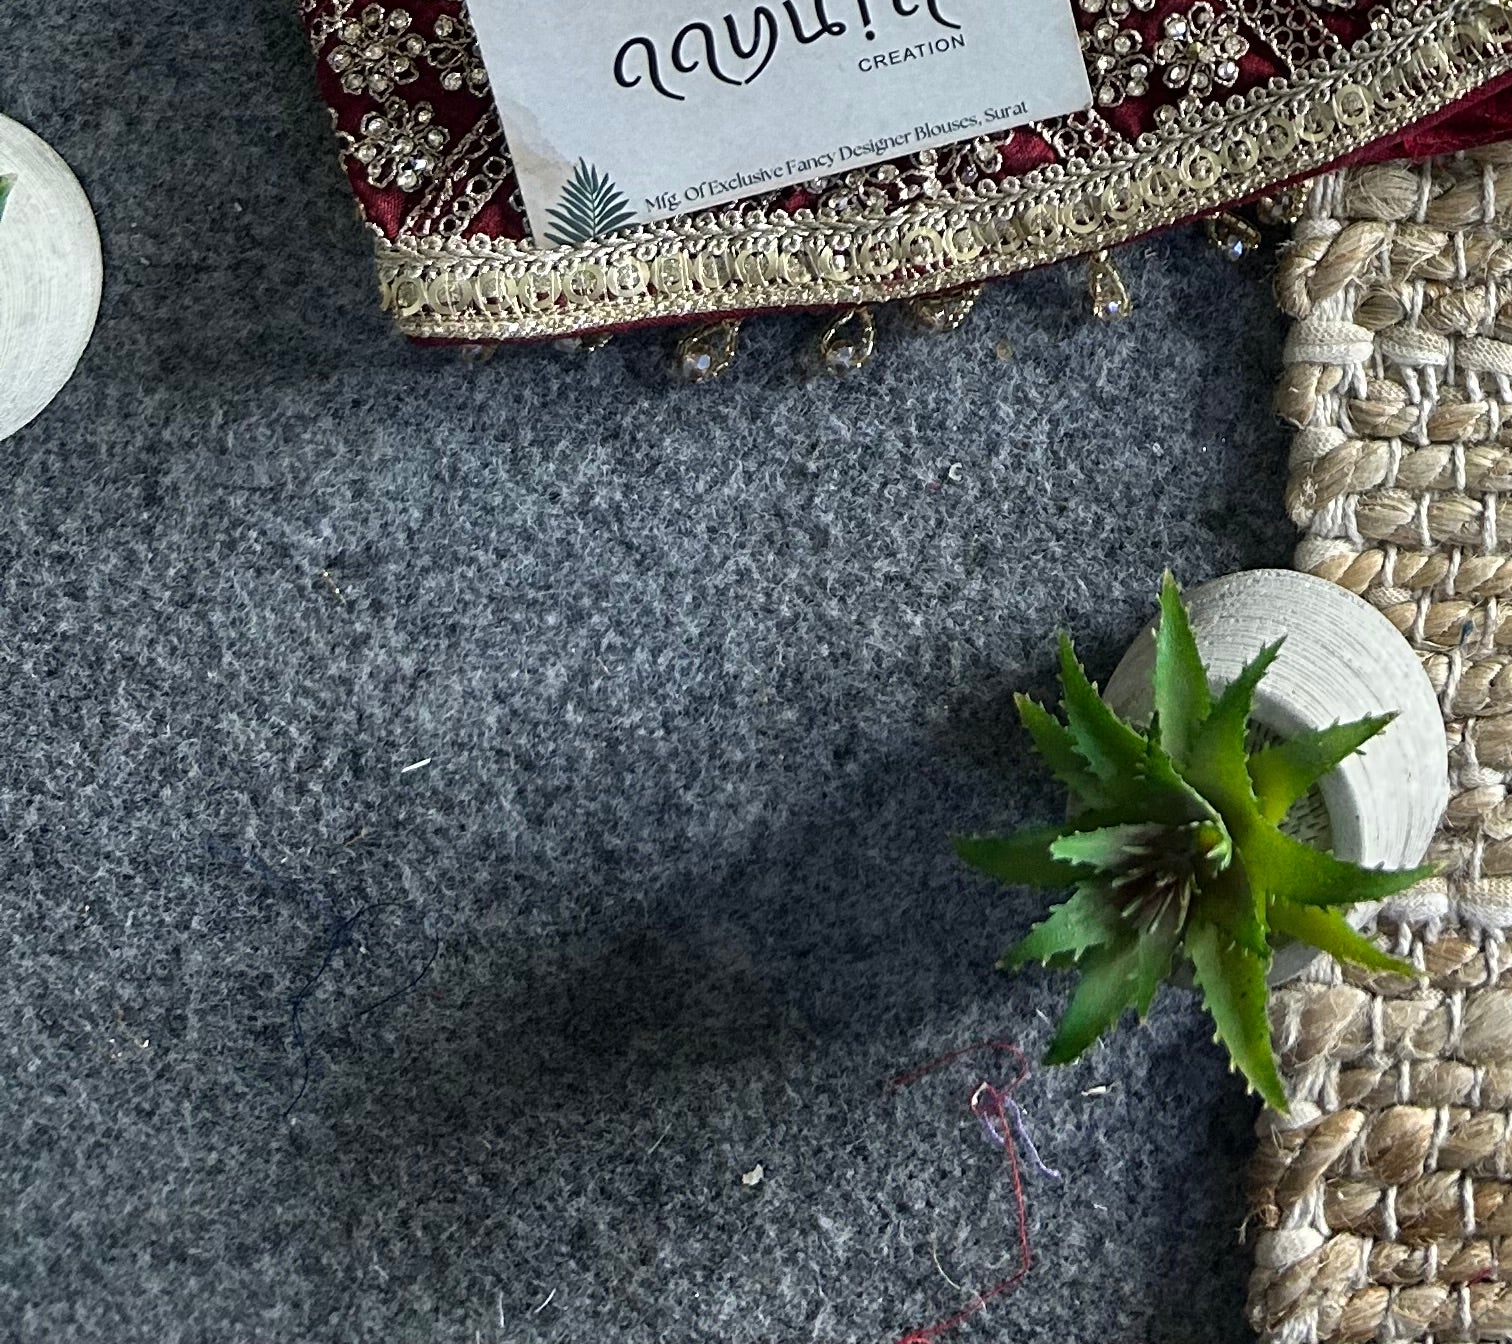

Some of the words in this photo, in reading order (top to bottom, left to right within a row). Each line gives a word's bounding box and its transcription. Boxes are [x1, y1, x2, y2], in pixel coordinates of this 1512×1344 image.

[858, 34, 966, 73] CREATION
[684, 181, 708, 202] Of
[709, 164, 783, 195] Exclusive
[786, 152, 835, 175] Fancy
[839, 131, 911, 161] Designer
[914, 115, 982, 141] Blouses,
[983, 101, 1028, 122] Surat
